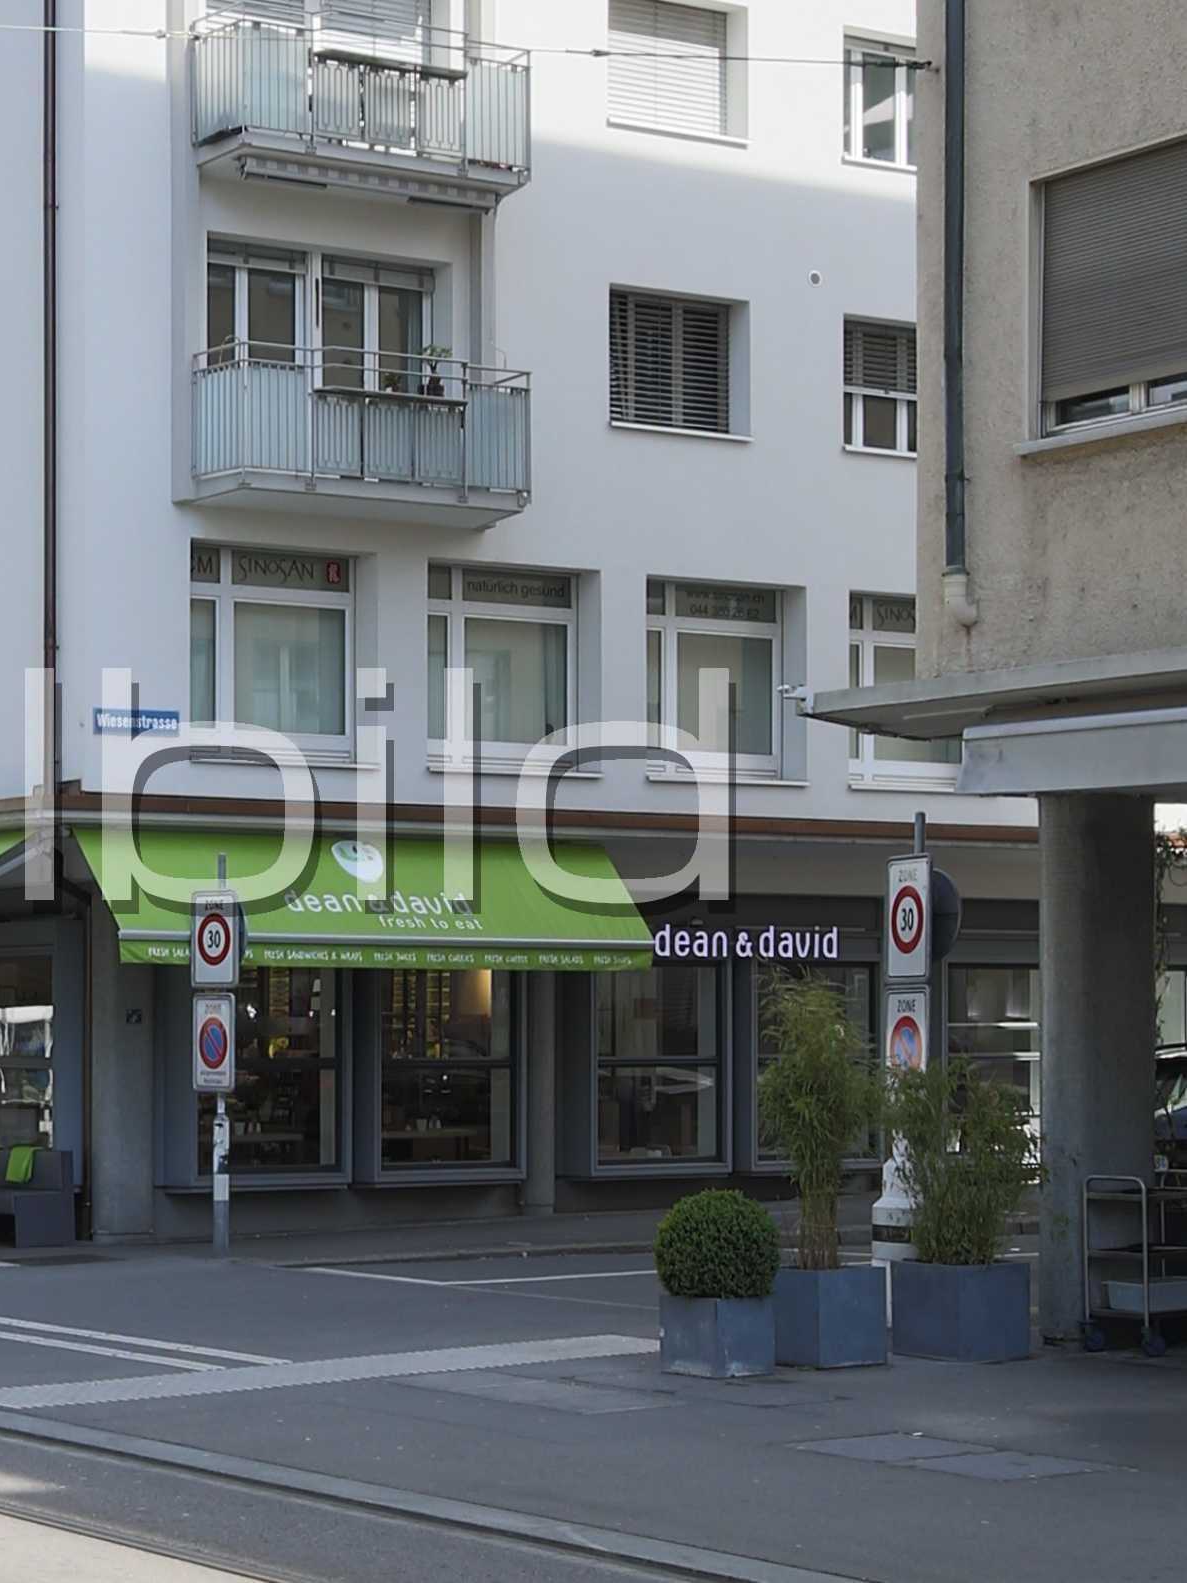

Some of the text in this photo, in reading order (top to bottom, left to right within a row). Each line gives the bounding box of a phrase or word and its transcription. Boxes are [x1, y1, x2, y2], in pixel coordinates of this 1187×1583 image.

[238, 555, 315, 583] SINOSAN
[520, 584, 565, 598] gesund
[96, 713, 178, 730] Wiesenstrasse
[898, 869, 918, 883] ZONE
[285, 890, 362, 912] dean
[393, 890, 474, 918] david
[378, 915, 484, 930] fresh to eat
[900, 908, 914, 931] 30
[206, 929, 222, 949] 30
[654, 923, 839, 959] dean & david
[897, 999, 917, 1013] ZONE
